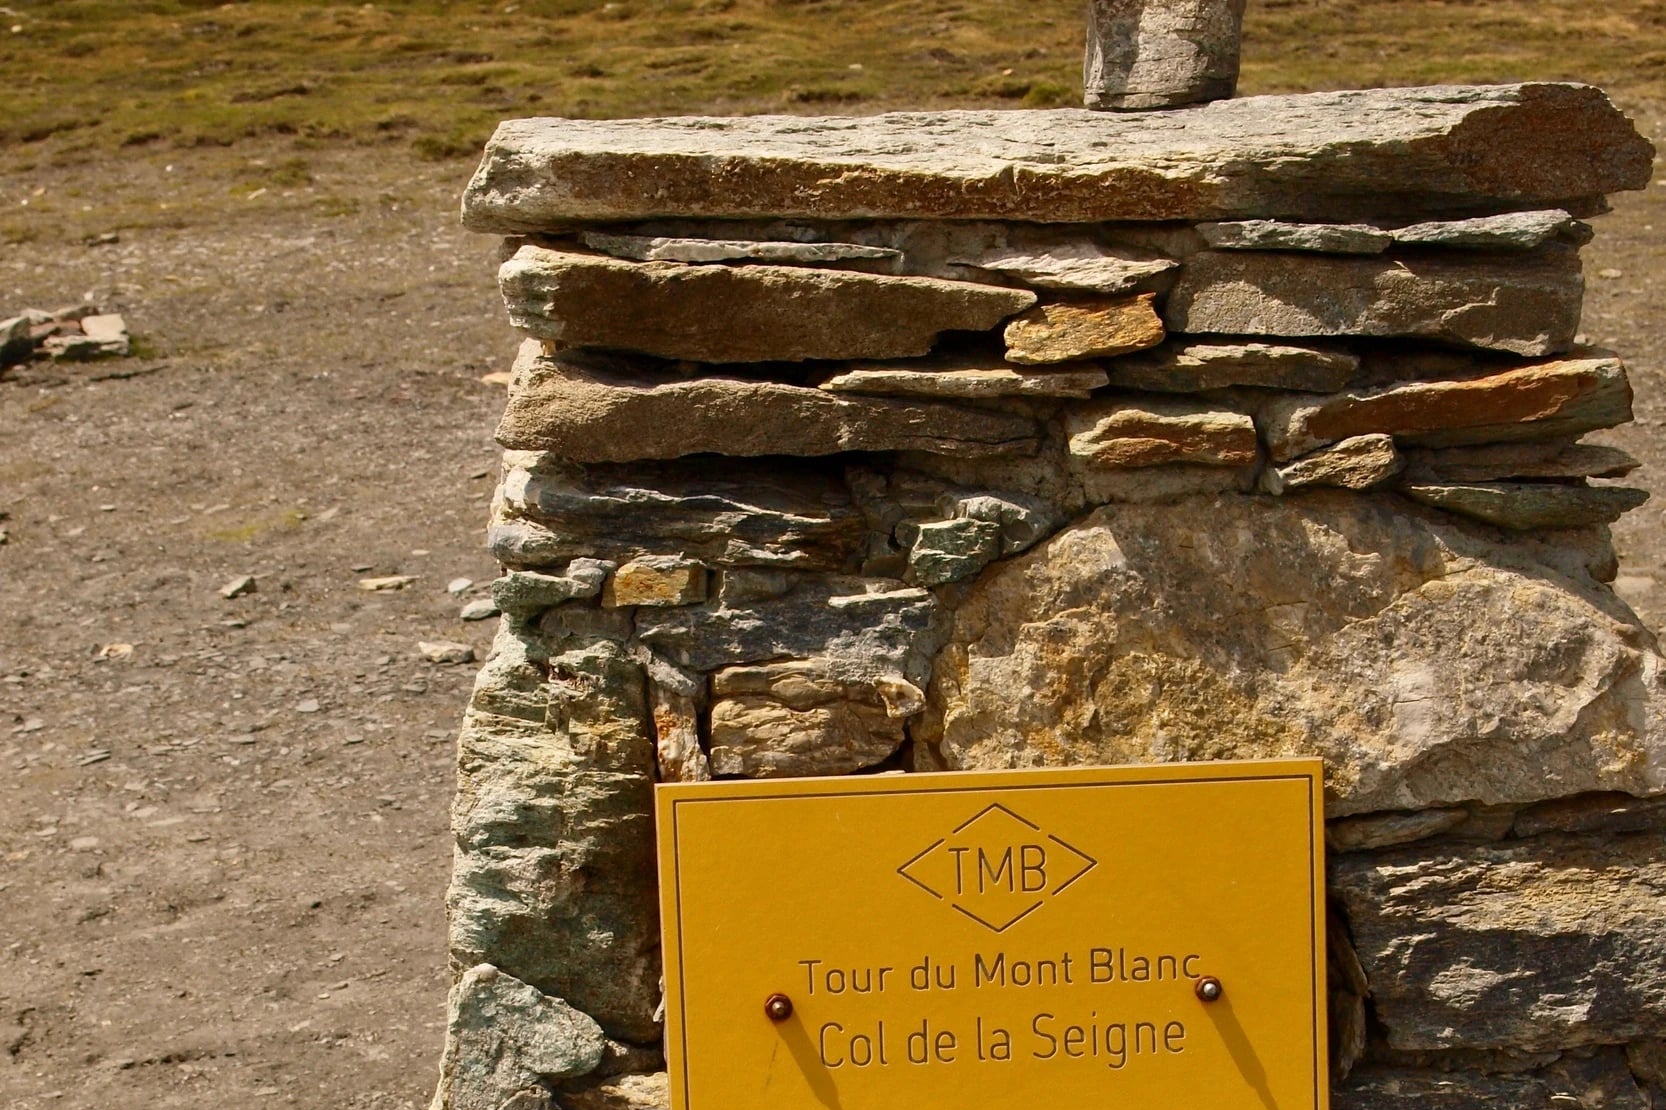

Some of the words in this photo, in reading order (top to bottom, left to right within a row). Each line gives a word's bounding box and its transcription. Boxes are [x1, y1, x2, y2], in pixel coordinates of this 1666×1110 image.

[947, 845, 1048, 895] TMB
[798, 958, 894, 995] Tour
[909, 955, 957, 992] du
[973, 952, 1075, 989] Mont
[1089, 948, 1201, 983] Blanc
[818, 1018, 890, 1069] Col
[905, 1016, 959, 1067] de
[974, 1014, 1014, 1063] la
[1030, 1010, 1188, 1070] Seigne
